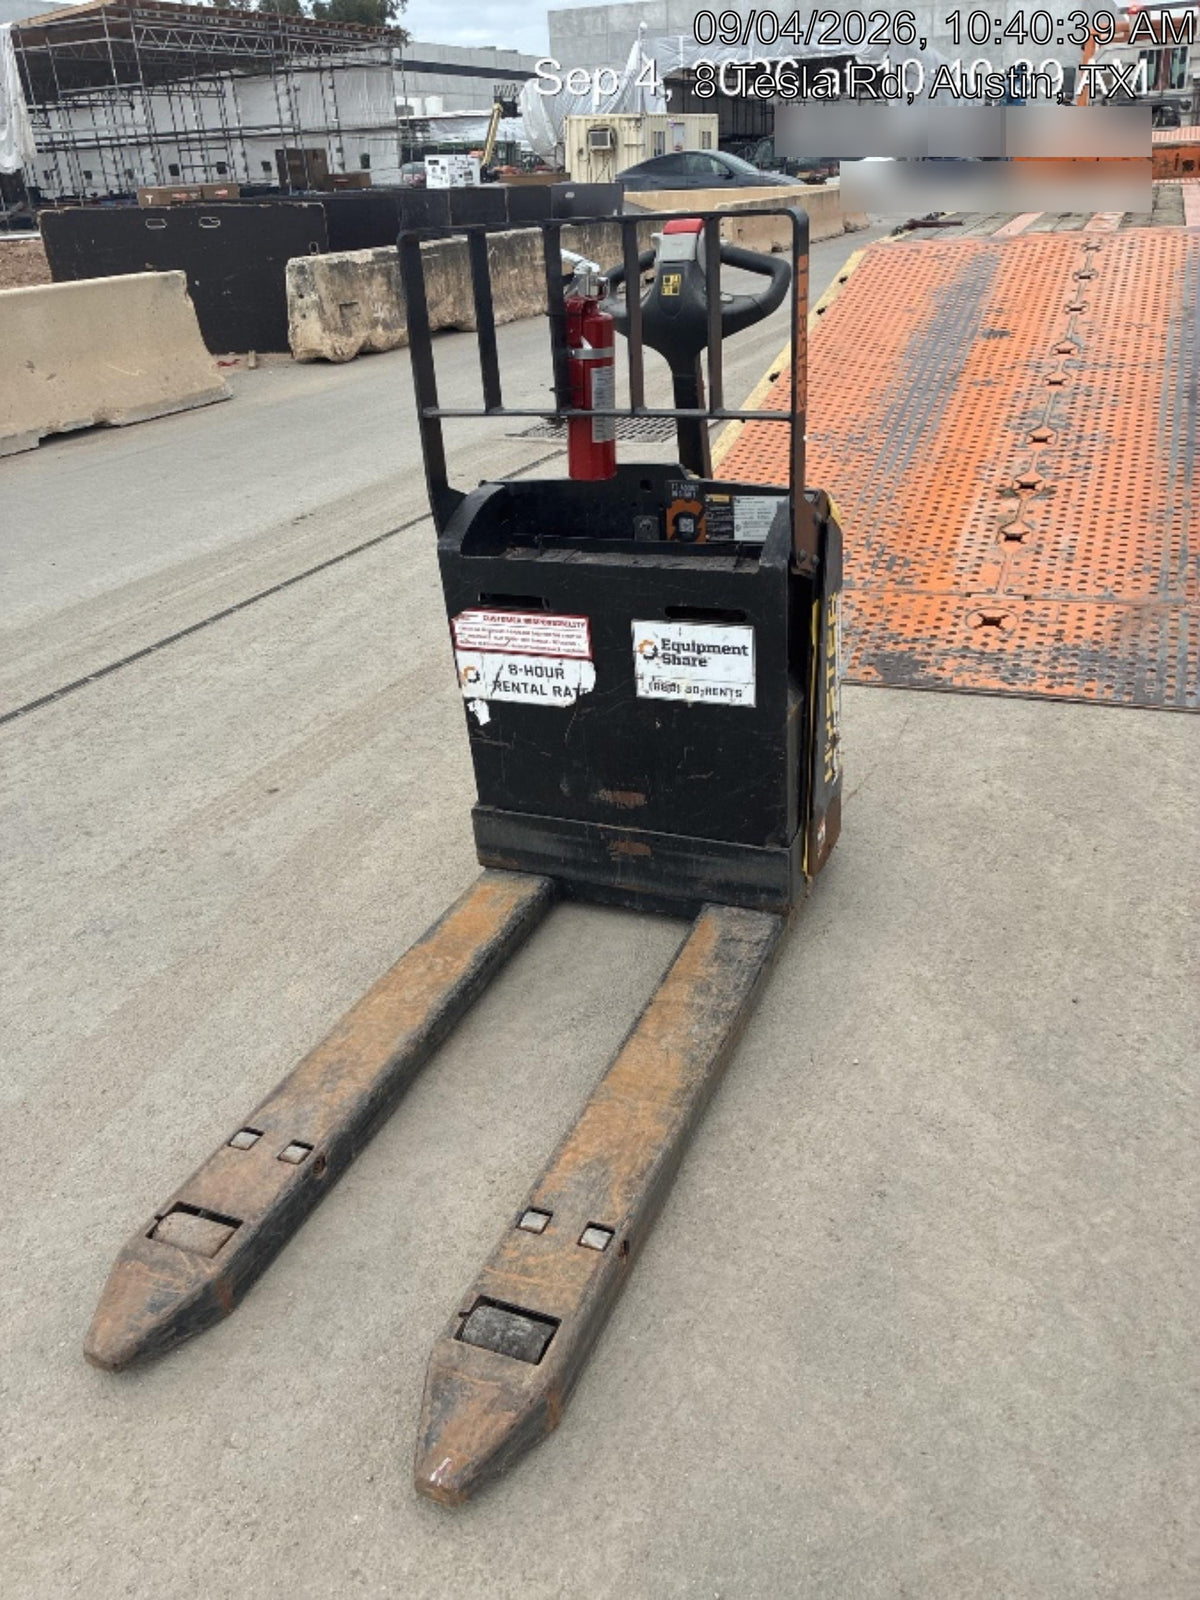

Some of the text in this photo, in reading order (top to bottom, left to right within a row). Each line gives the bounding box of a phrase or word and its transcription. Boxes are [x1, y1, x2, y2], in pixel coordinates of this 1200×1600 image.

[660, 638, 750, 657] Equipment
[661, 652, 709, 668] Share
[507, 663, 566, 681] 8-HOUR
[493, 680, 548, 697] RENTAL
